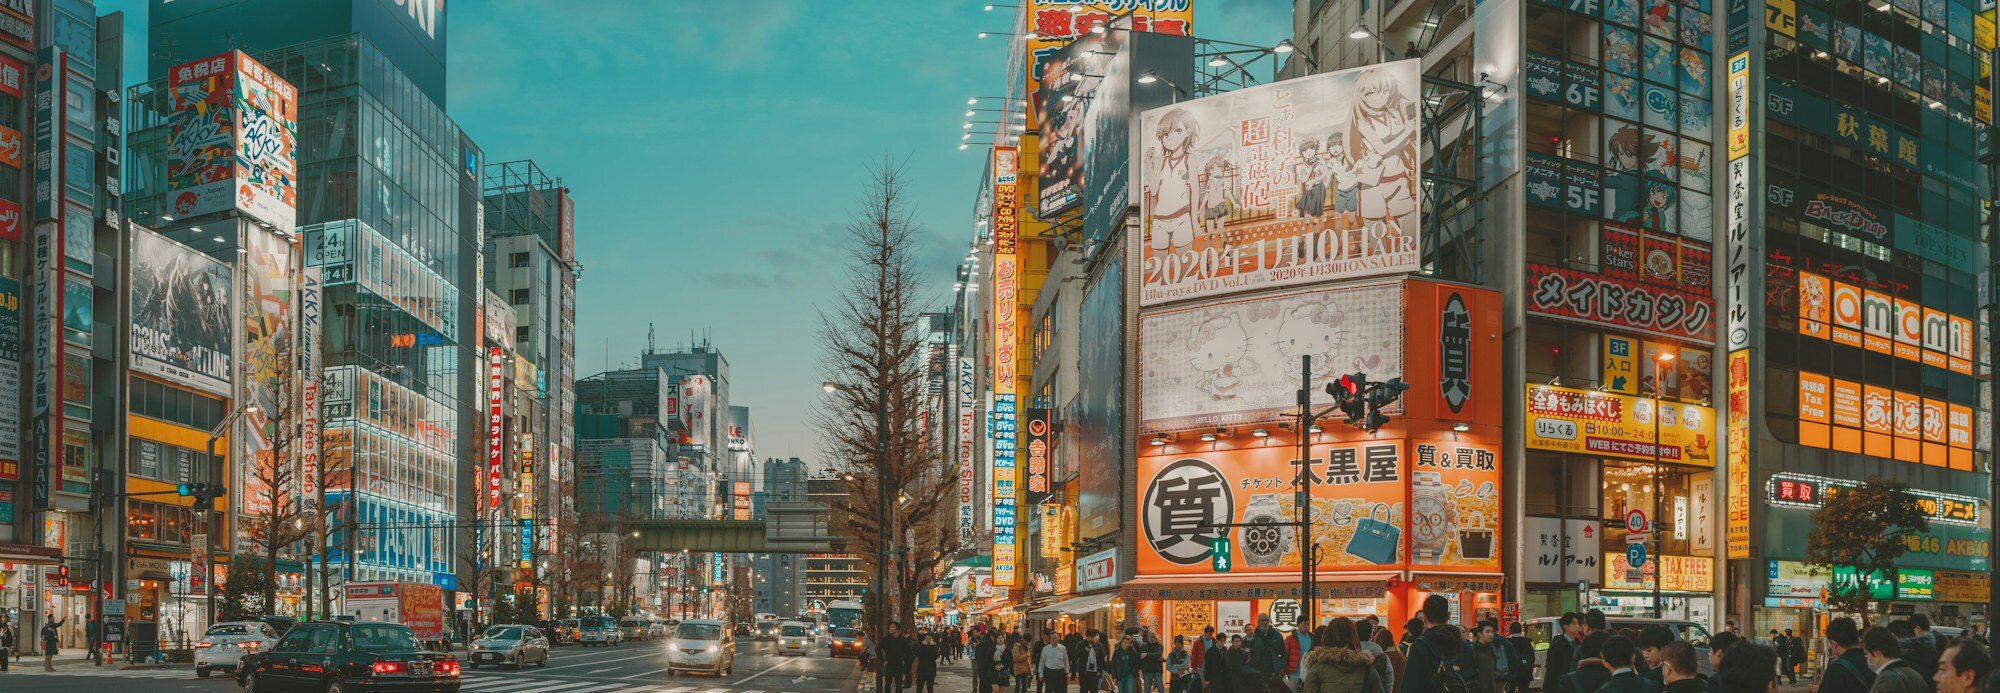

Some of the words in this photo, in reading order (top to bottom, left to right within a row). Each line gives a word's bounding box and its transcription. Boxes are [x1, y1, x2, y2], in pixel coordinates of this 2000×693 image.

[1766, 4, 1795, 30] 7F
[177, 58, 226, 83] 免税店
[1733, 59, 1745, 72] 3F
[242, 59, 294, 102] 愛客免税店
[1566, 83, 1599, 107] 6F
[1735, 79, 1743, 128] りらくる
[1768, 93, 1793, 115] 5F
[37, 88, 52, 205] 愛三電機
[245, 119, 281, 160] AKKY
[1271, 89, 1294, 186] とある科学の
[1837, 111, 1918, 167] 秋葉館
[1242, 116, 1271, 208] 超電磁砲
[206, 186, 225, 195] Japan
[998, 185, 1015, 193] DVD
[1566, 186, 1599, 211] 5F
[1768, 184, 1793, 207] 5F
[316, 232, 345, 249] 24h
[1371, 219, 1403, 240] ON
[315, 250, 345, 261] OPEN
[1371, 235, 1415, 256] AIR
[1144, 226, 1369, 288] 2020年1月10日
[1605, 255, 1634, 271] Stars
[305, 274, 318, 326] AKKY
[1533, 272, 1710, 336] メイドカジノ
[1440, 310, 1471, 399] 質
[1606, 358, 1631, 374] 入口
[961, 360, 973, 398] AKKY
[1533, 391, 1619, 418] 全身もみほぐし
[1803, 392, 1822, 406] Tax
[304, 382, 318, 451] Tax-free
[1195, 415, 1219, 424] HELLO
[1221, 413, 1243, 422] KITTY
[1682, 416, 1701, 427] No.1
[1802, 405, 1824, 418] Free
[1864, 391, 1945, 440] あみあみ
[490, 414, 501, 458] カラオケ
[996, 423, 1014, 431] DVD
[1538, 421, 1574, 437] りらくる
[996, 442, 1014, 450] DVD
[1531, 439, 1581, 451] 秋葉原中央通り店
[1588, 439, 1611, 452] WEB
[1739, 426, 1748, 465] TAX
[35, 419, 47, 500] AISAN
[1288, 444, 1399, 488] 大黒屋
[1416, 444, 1437, 468] 質
[1440, 452, 1451, 469] &
[1455, 447, 1495, 471] 買取
[304, 453, 318, 494] Shop
[1240, 476, 1283, 491] チケット
[961, 469, 973, 503] Shop
[1739, 471, 1748, 521] FREE
[1780, 481, 1812, 501] 買取
[1153, 471, 1223, 553] 質
[1697, 493, 1707, 545] ルノアール
[1941, 500, 1975, 519] アニメ
[995, 517, 1014, 525] DVD
[1630, 515, 1642, 527] 40
[1630, 549, 1639, 563] P
[1946, 538, 1990, 558] AKB48
[136, 561, 148, 569] Cafe
[149, 561, 168, 570] MOCO
[1538, 552, 1597, 567] ルノアール
[1664, 557, 1682, 575] TAX
[1685, 558, 1707, 575] FREE
[1158, 588, 1171, 598] 時計
[1223, 588, 1242, 598] ダイヤ
[1247, 587, 1286, 597] 各種チケット
[1665, 575, 1708, 590] 면세점
[1273, 600, 1299, 628] 質
